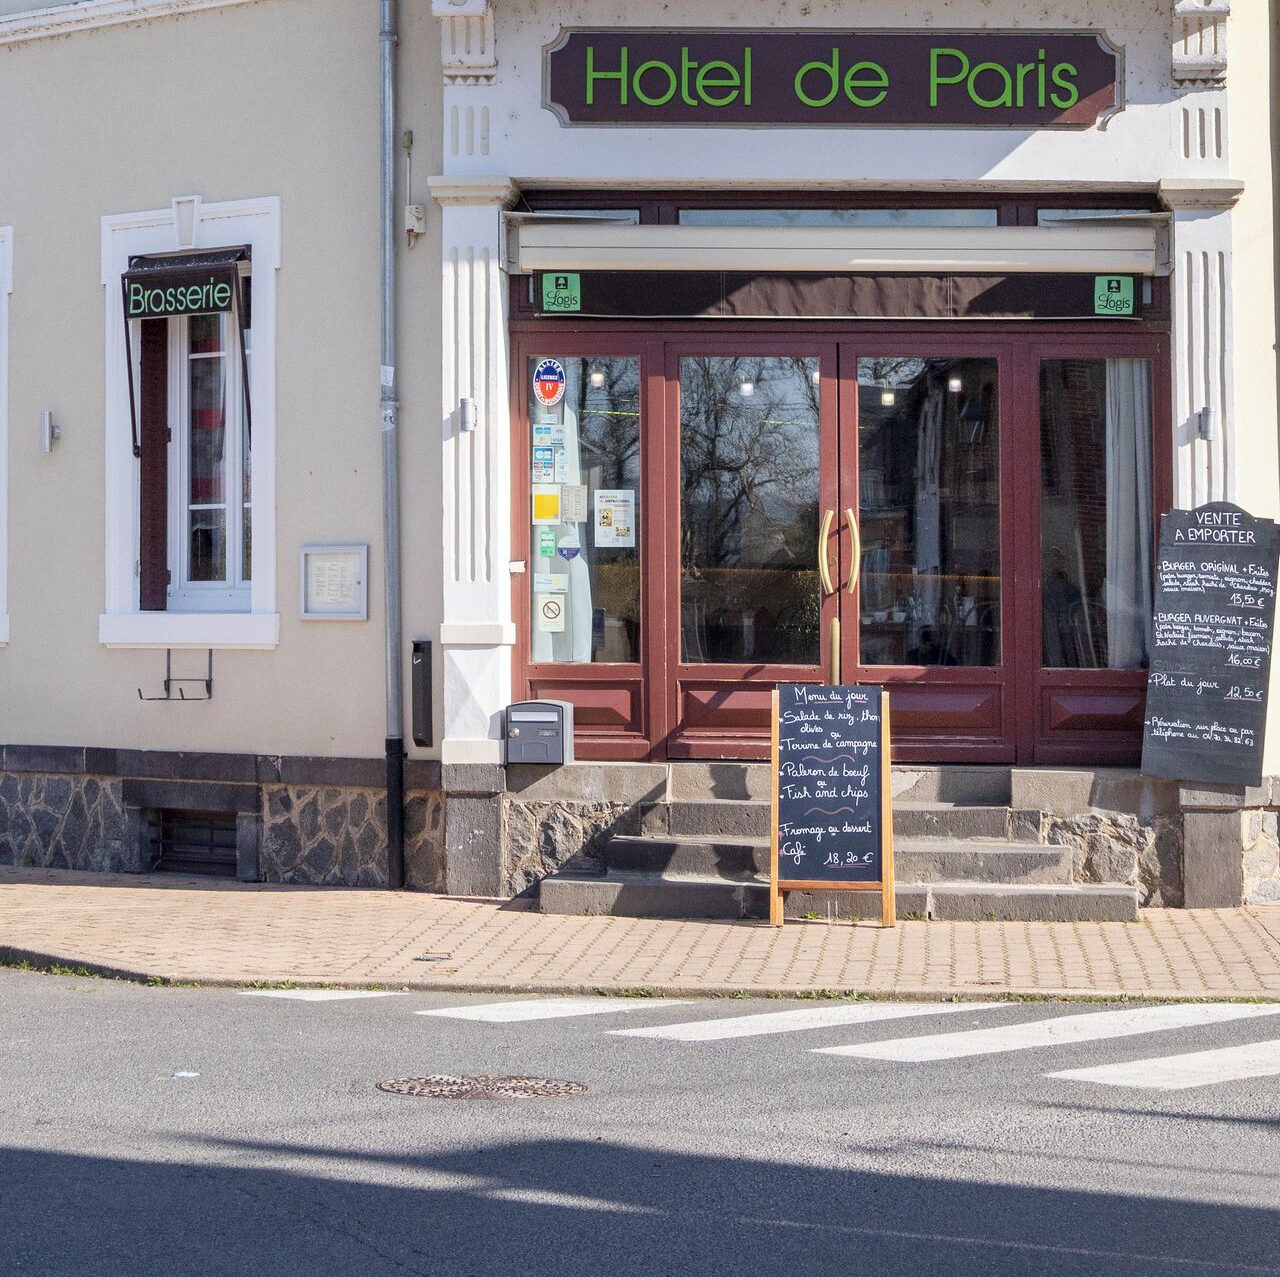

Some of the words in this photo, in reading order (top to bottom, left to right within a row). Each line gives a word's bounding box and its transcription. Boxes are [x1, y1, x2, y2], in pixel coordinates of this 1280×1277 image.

[585, 46, 752, 107] Hotel
[794, 47, 890, 108] de
[930, 47, 1080, 108] Paris
[130, 276, 231, 313] Brasserie
[545, 289, 578, 309] Logis
[1097, 292, 1131, 312] Logis
[546, 383, 554, 391] IV
[1195, 512, 1242, 526] VENTE
[1175, 529, 1185, 541] A
[1188, 528, 1256, 543] EMPORTER
[1161, 561, 1196, 572] BURGER
[1248, 564, 1270, 576] Frites
[1230, 593, 1255, 608] 13,50
[1257, 598, 1265, 607] €
[1158, 612, 1192, 623] BURGER
[1194, 614, 1243, 625] AUVERGNAT
[1249, 617, 1268, 628] Frites
[1254, 658, 1261, 667] €
[1151, 673, 1176, 686] Plat
[1180, 677, 1194, 687] du
[1196, 678, 1219, 695] jour
[794, 687, 827, 704] Menu
[829, 691, 842, 700] du
[845, 690, 869, 709] jour
[783, 710, 821, 724] Salade
[824, 710, 834, 720] de
[860, 709, 881, 723] thon
[800, 723, 823, 733] olives
[1150, 727, 1185, 742] téléphone
[1151, 716, 1192, 729] Réservation
[1195, 723, 1209, 731] sur
[1211, 721, 1227, 738] place
[1241, 728, 1255, 739] par
[781, 738, 820, 751] Terrine
[822, 739, 833, 748] de
[836, 740, 878, 756] campagne
[781, 762, 827, 777] Paleron
[828, 766, 839, 777] de
[817, 780, 828, 788] ou
[782, 784, 812, 799] Fish
[815, 787, 839, 798] and
[841, 784, 869, 807] chips
[780, 822, 827, 842] Fromage
[828, 826, 840, 835] ou
[842, 821, 872, 833] dessert
[782, 841, 807, 865] Café
[862, 852, 874, 863] €
